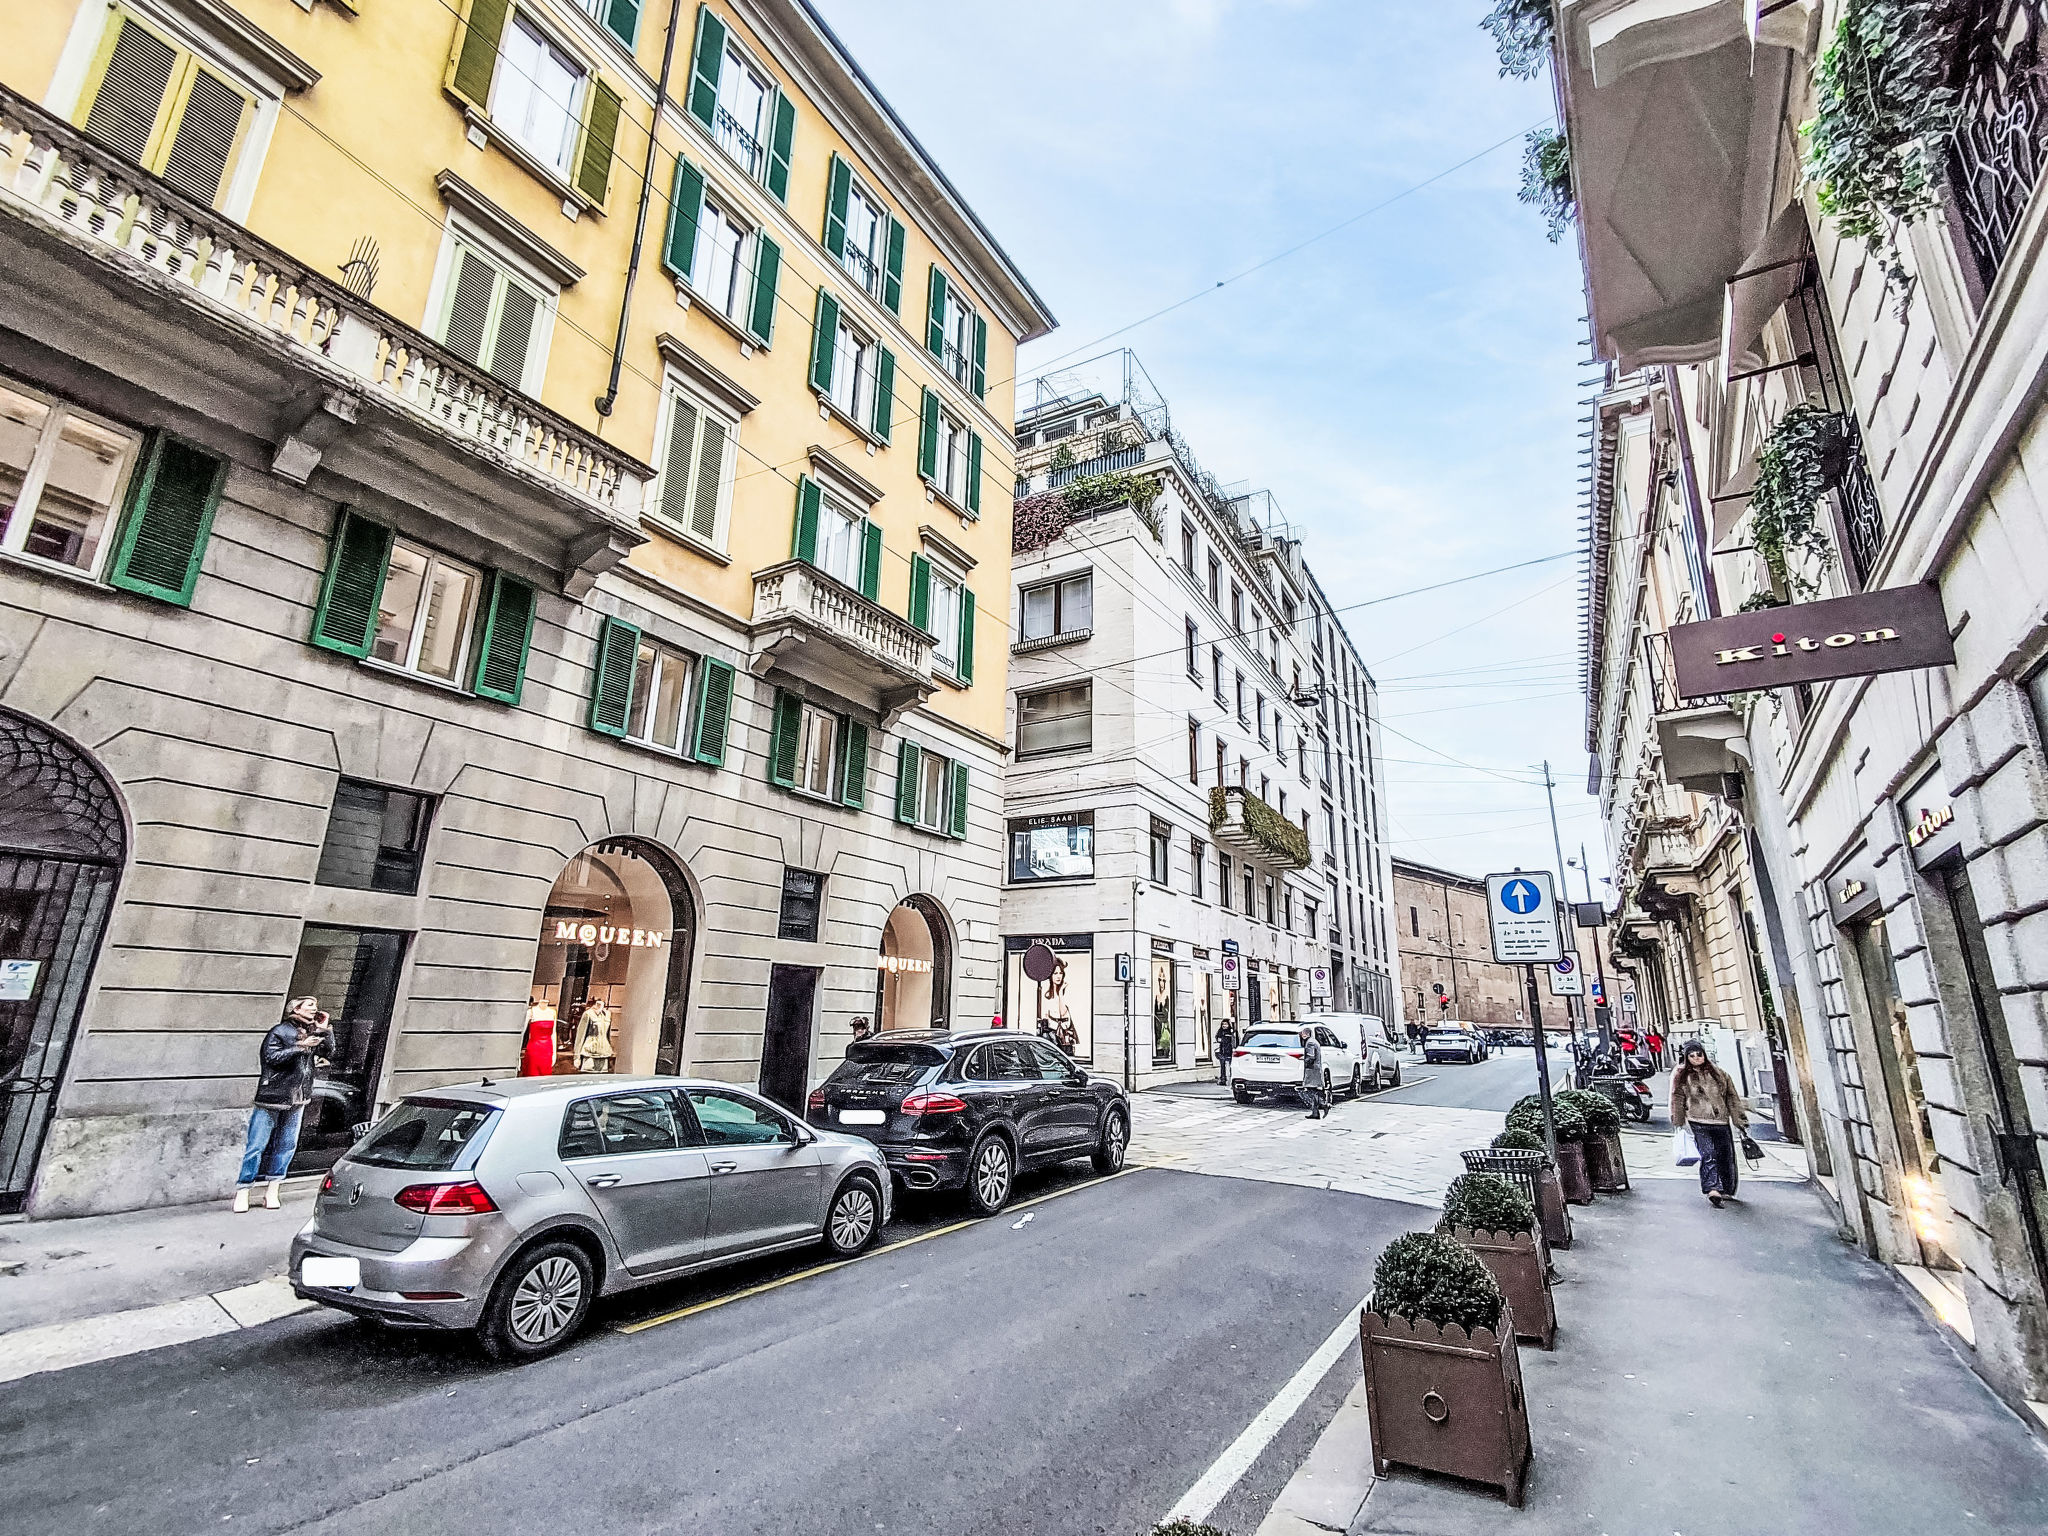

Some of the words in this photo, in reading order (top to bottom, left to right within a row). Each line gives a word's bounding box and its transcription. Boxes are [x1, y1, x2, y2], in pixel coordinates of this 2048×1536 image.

[1713, 626, 1900, 666] Kiton
[1028, 817, 1046, 825] ELIE
[1051, 815, 1072, 823] SAAB
[1908, 804, 1954, 848] Kiton
[1839, 879, 1863, 904] Kiton
